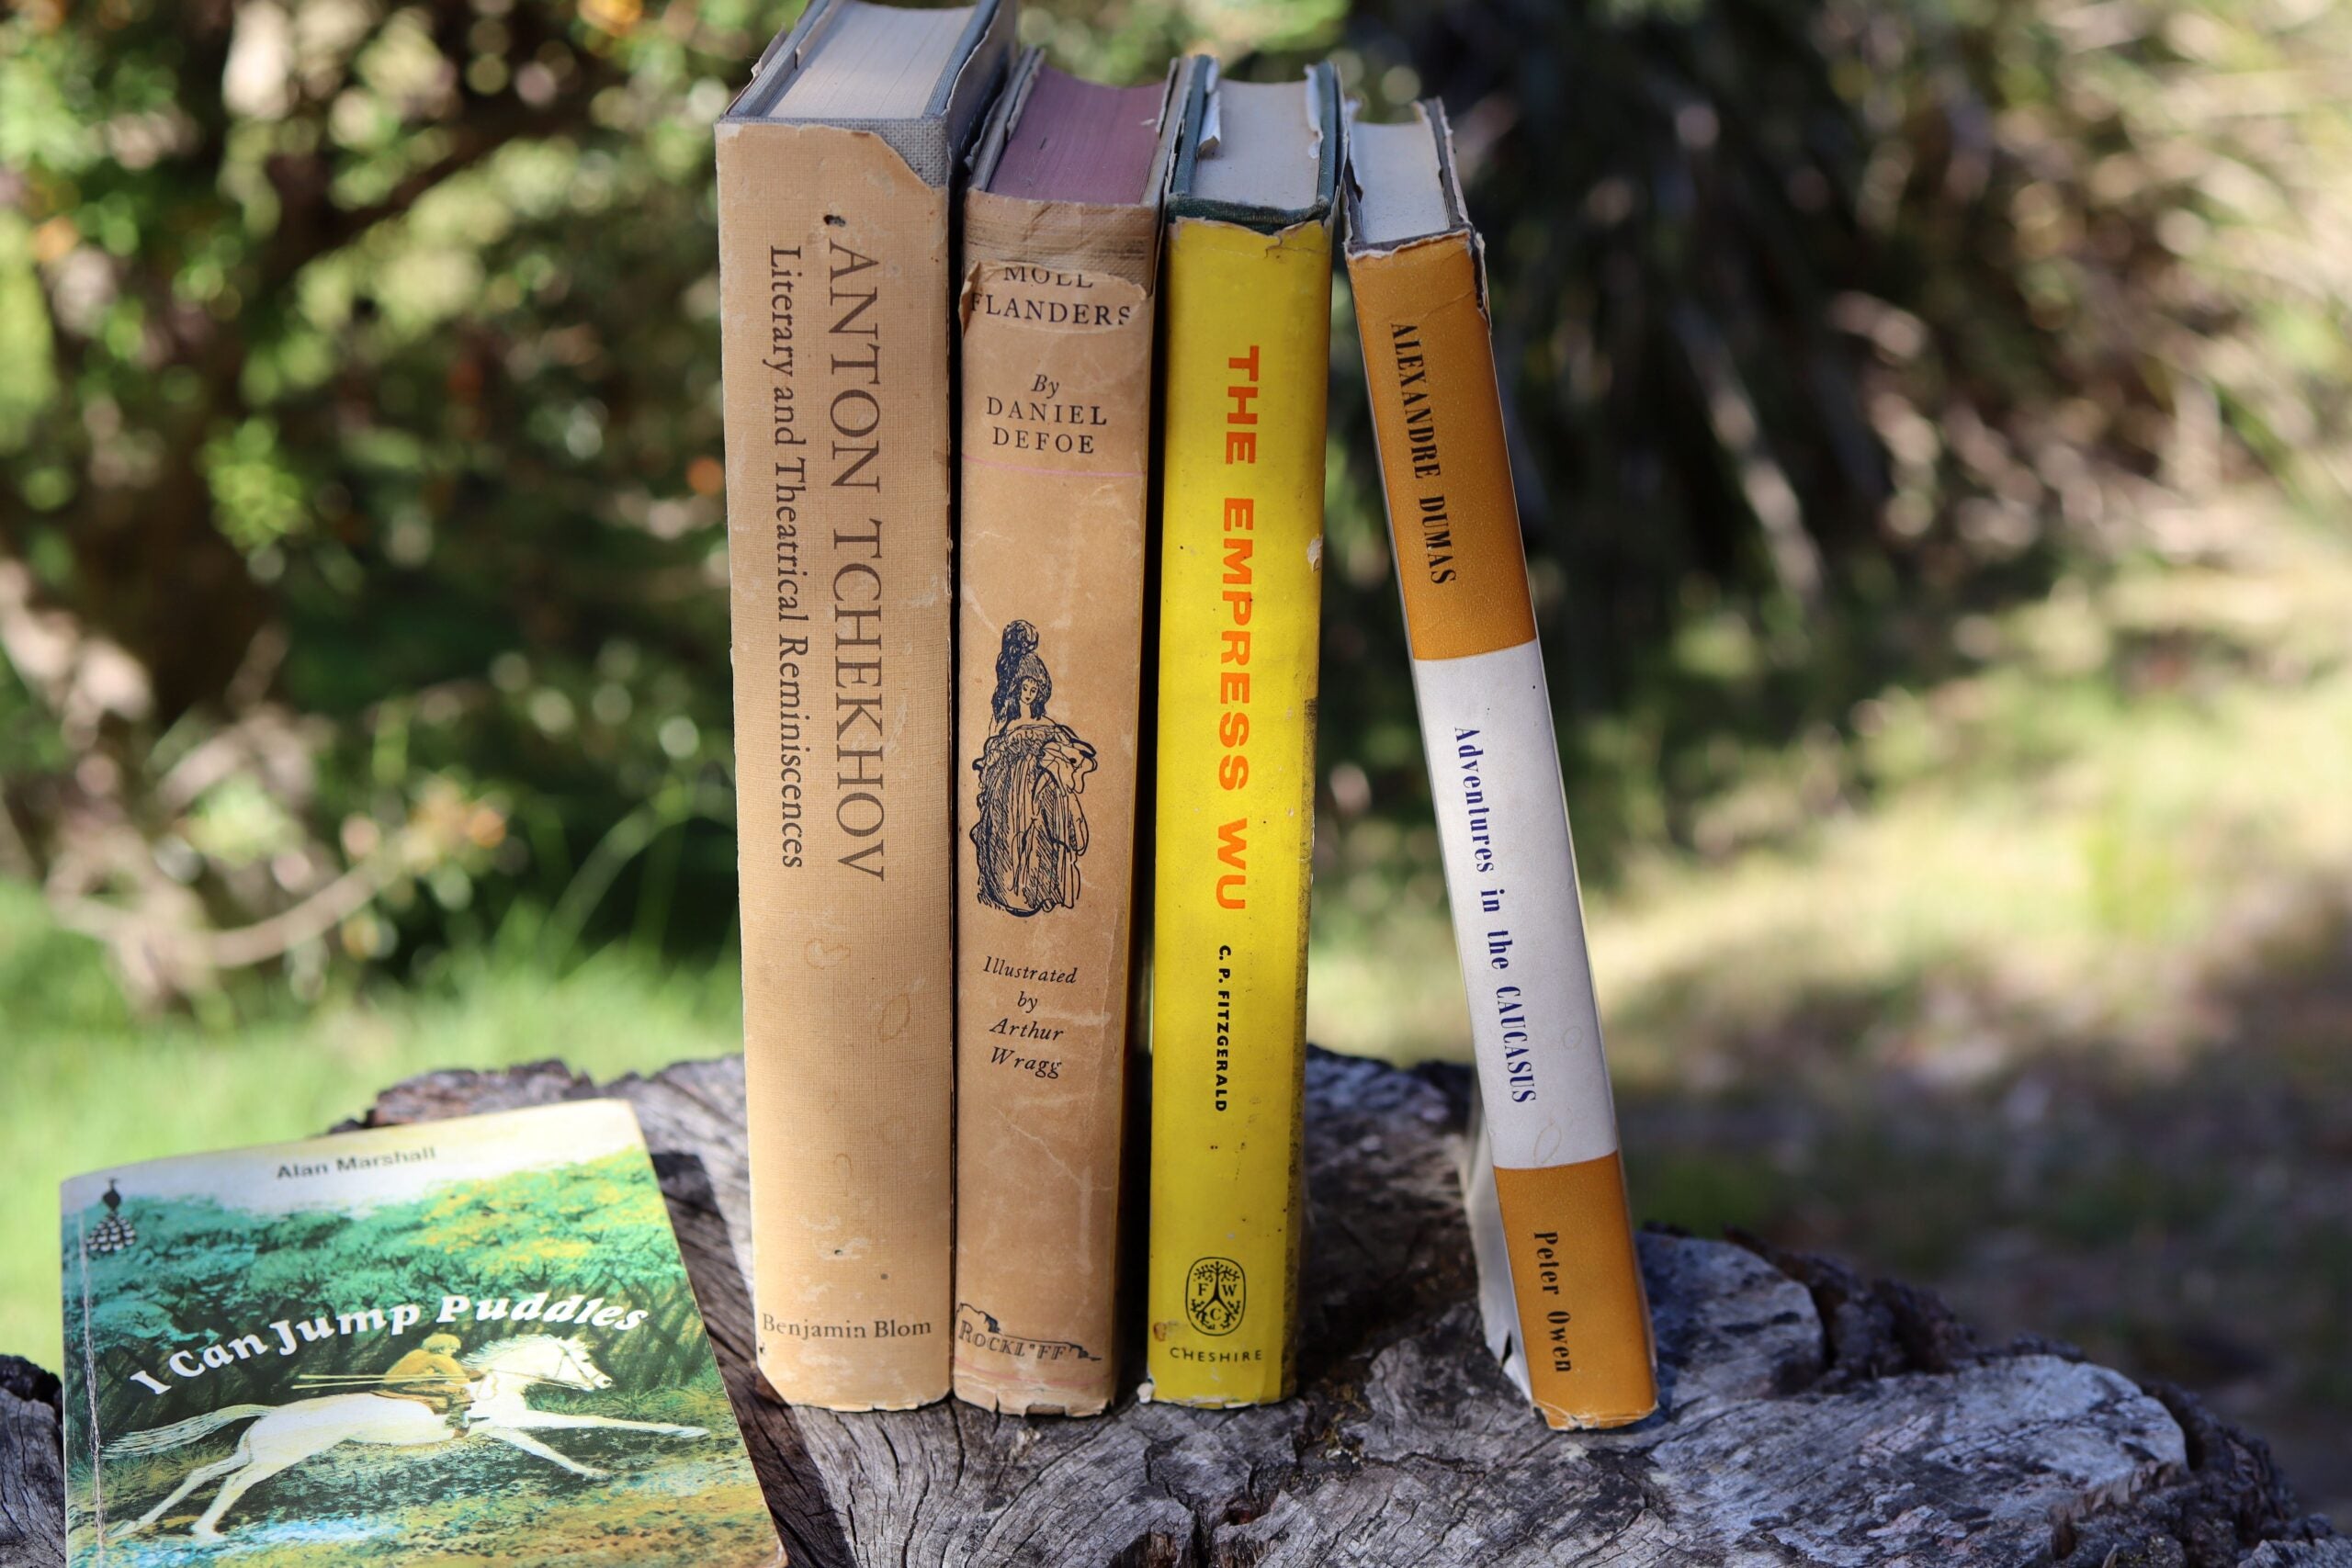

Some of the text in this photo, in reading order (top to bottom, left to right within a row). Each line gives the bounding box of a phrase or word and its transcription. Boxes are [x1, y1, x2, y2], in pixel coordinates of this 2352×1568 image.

[1003, 265, 1093, 288] MOLL
[970, 292, 1132, 325] FLANDERS
[1031, 374, 1059, 399] By
[987, 396, 1108, 425] DANIEL
[992, 426, 1094, 454] DEFOE
[1390, 323, 1457, 585] ALEXANDRE DUMAS
[763, 245, 810, 868] Literary and Theatrical Reminiscences
[828, 238, 884, 882] ANTON TCHEKHOV
[1216, 345, 1260, 909] THE EMPRESS WU
[1454, 728, 1537, 1103] Adventures in the CAUCASUS
[983, 955, 1079, 984] Illustrated
[1017, 990, 1038, 1014] by
[989, 1017, 1064, 1042] Arthur
[990, 1045, 1062, 1079] Wragg
[1215, 990, 1230, 1112] FITZGERALD
[277, 1145, 436, 1180] Alan Marshall
[1198, 1283, 1238, 1297] F W
[1533, 1232, 1572, 1373] Peter Owen
[130, 1292, 649, 1395] I Can Jump Puddles
[763, 1313, 933, 1341] Benjamin Blom
[1170, 1347, 1263, 1363] CHESHIRE
